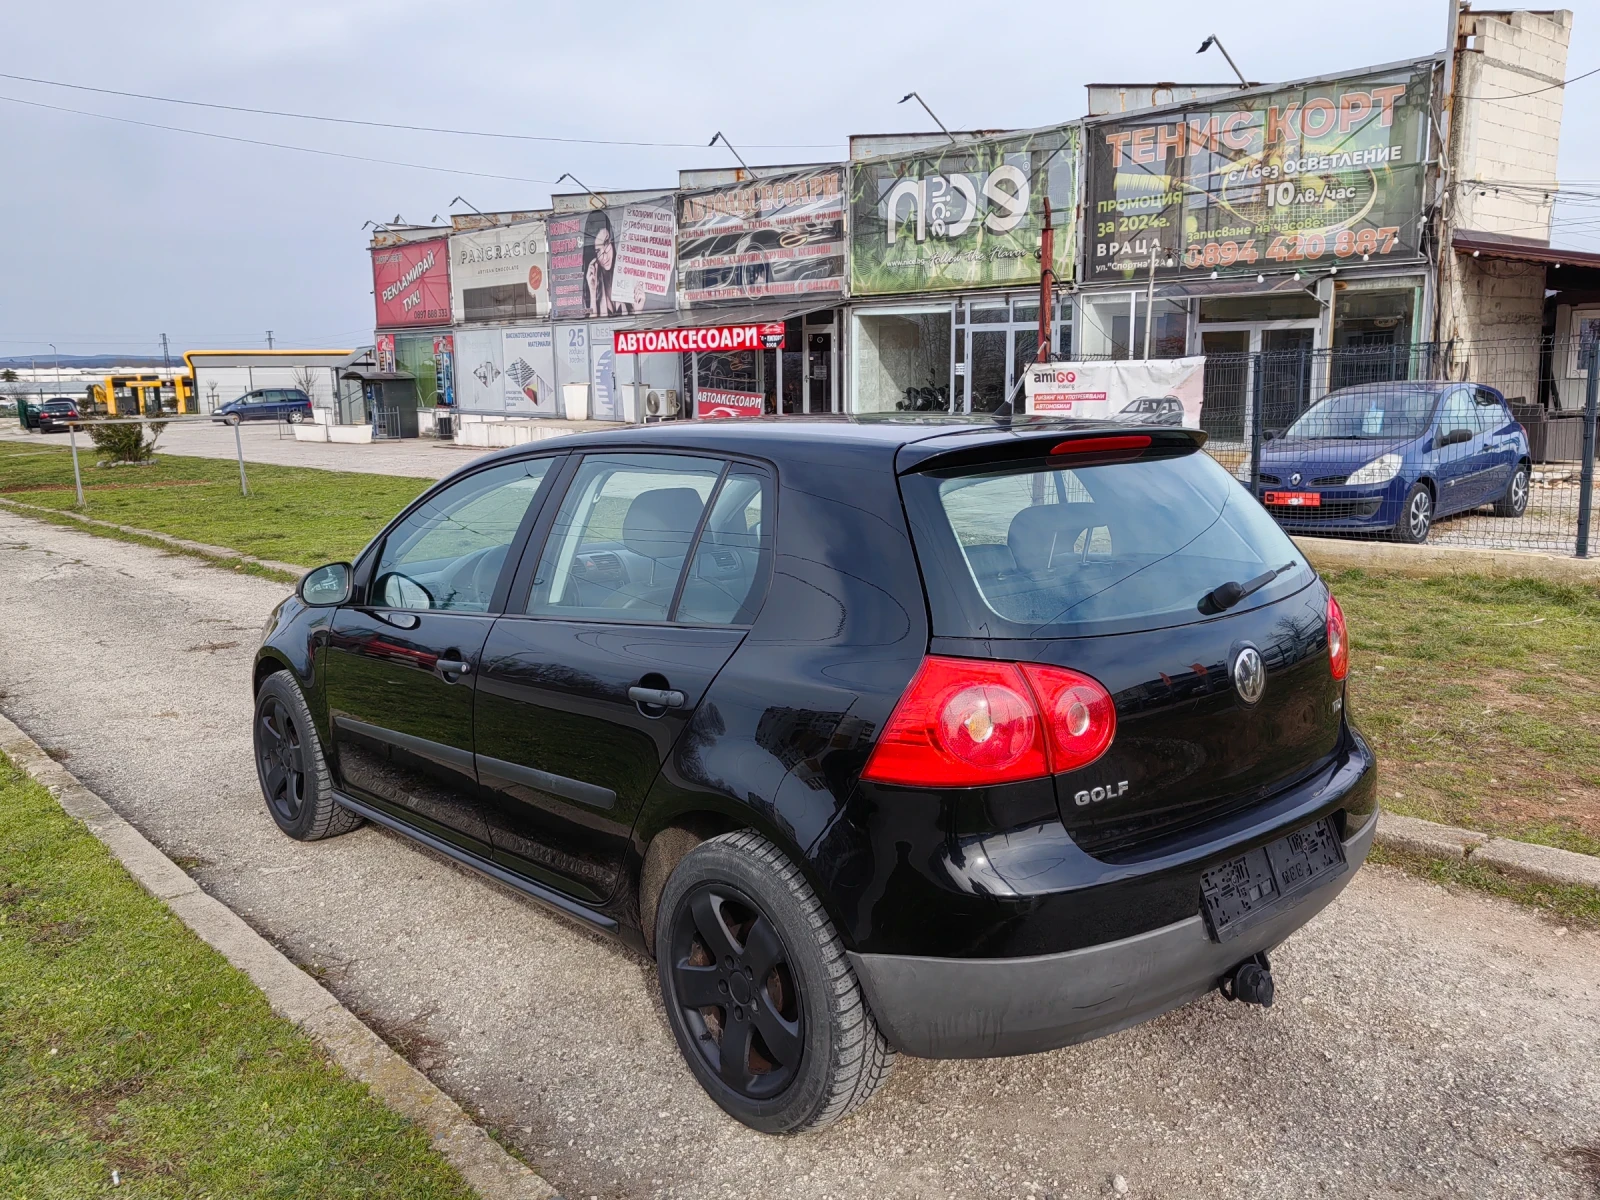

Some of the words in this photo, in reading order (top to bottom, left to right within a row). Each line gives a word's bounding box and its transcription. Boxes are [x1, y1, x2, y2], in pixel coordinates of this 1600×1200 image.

[1106, 111, 1253, 168] ТЕНИС
[1267, 84, 1406, 144] КОРТ
[1252, 164, 1278, 178] без
[1284, 146, 1402, 172] ОСВЕТЛЕНИЕ
[681, 173, 838, 224] АВТОАКСЕСОАРИ
[1098, 191, 1183, 214] ПРОМОЦИЯ
[1097, 222, 1115, 238] за
[1119, 214, 1170, 232] 2024г.
[1187, 226, 1251, 242] записване
[1255, 224, 1270, 234] на
[1274, 216, 1324, 231] часове:
[460, 240, 536, 264] PANCRACIO
[646, 248, 668, 258] РЕКЛАМА
[649, 237, 672, 247] РЕКЛАМА
[1096, 238, 1162, 256] ВРАЦА
[1185, 240, 1258, 270] 0894
[1266, 234, 1326, 262] 420
[1334, 226, 1400, 258] 887
[886, 258, 925, 268] www.nice.bg
[382, 249, 435, 304] РЕКЛАМИРАЙ
[402, 290, 420, 312] ТУК!
[568, 328, 584, 346] 25
[618, 327, 758, 352] АВТОАКСЕСОАРИ
[1034, 369, 1076, 383] amiGO
[698, 392, 762, 408] АВТОАКСЕСОАРИ
[1074, 780, 1128, 806] GOLF
